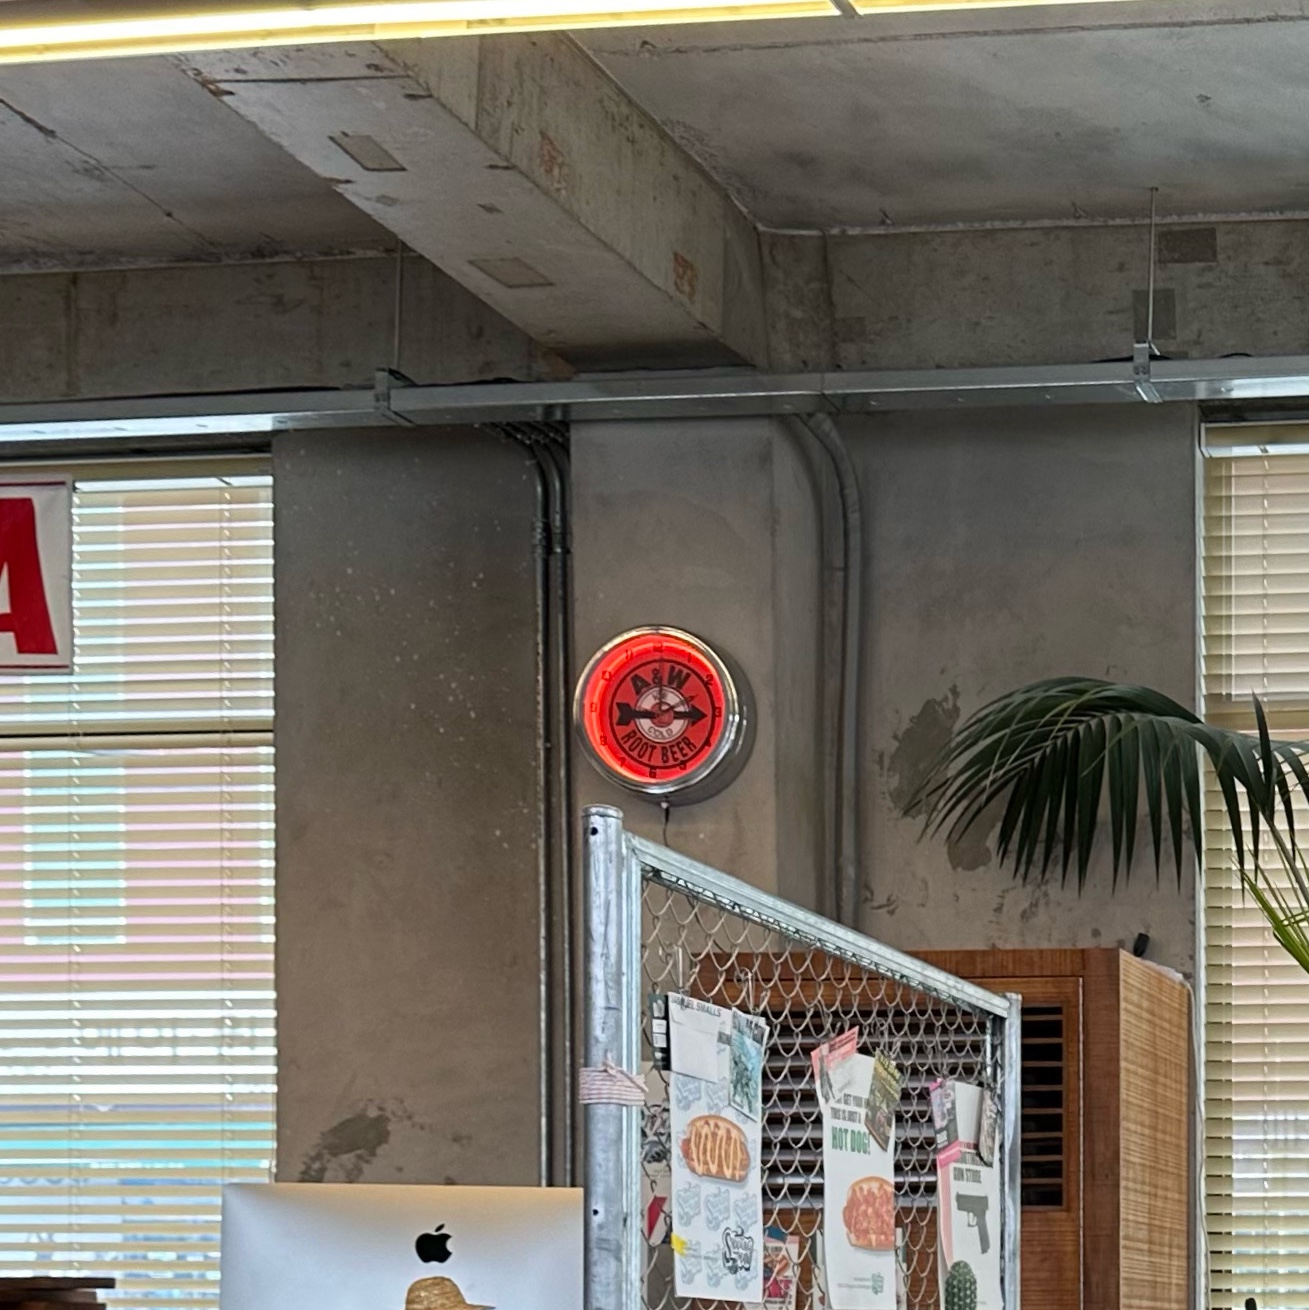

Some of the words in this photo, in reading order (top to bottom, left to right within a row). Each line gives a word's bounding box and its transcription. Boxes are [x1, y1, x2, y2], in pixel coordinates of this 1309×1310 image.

[647, 726, 674, 738] COLD
[621, 729, 658, 763] ROOT
[661, 736, 698, 764] BEER
[832, 1126, 848, 1151] HOT
